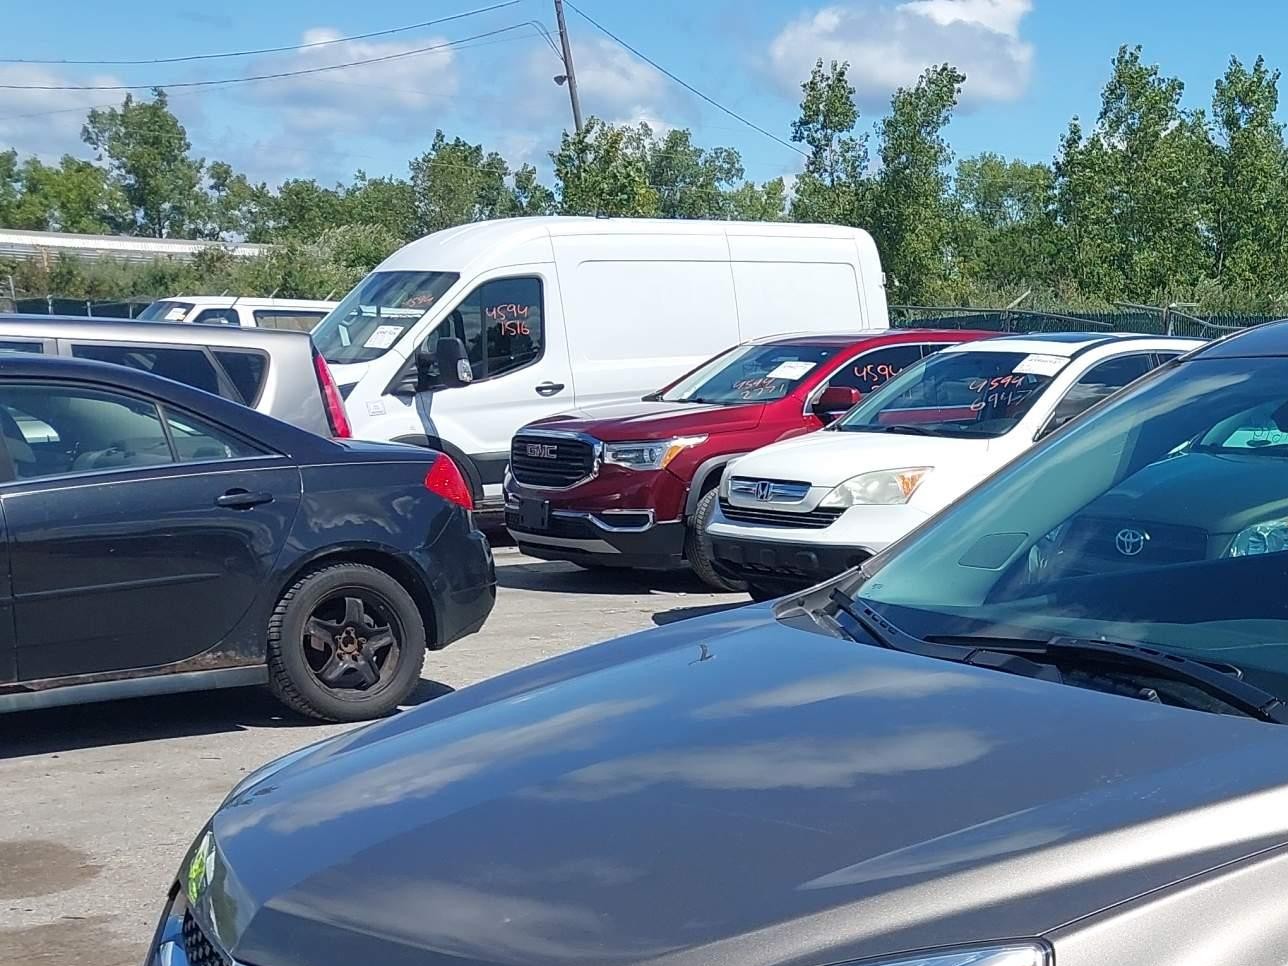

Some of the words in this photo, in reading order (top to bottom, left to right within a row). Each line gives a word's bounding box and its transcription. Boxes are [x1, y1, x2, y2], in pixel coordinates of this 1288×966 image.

[485, 304, 529, 321] 4594
[500, 320, 530, 336] 1516
[969, 375, 1025, 393] 4594
[527, 443, 558, 459] GMC
